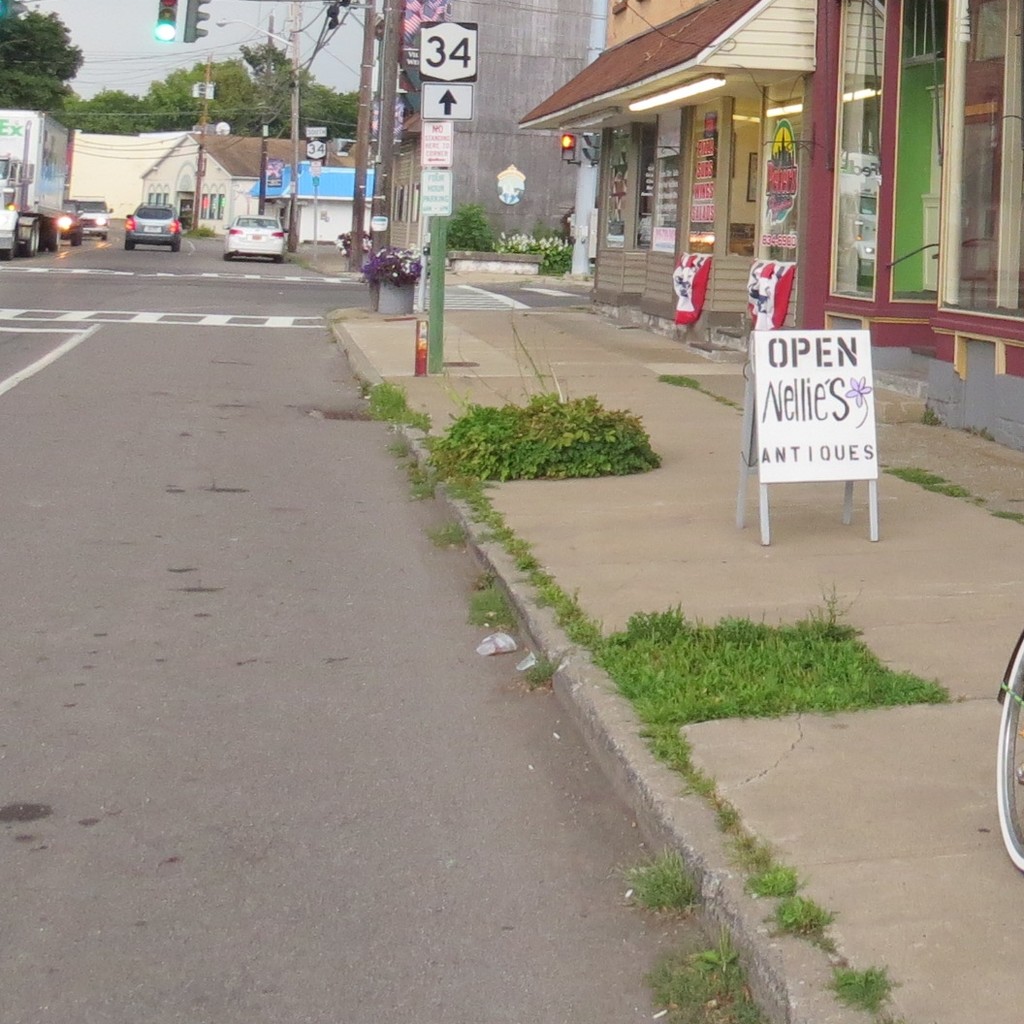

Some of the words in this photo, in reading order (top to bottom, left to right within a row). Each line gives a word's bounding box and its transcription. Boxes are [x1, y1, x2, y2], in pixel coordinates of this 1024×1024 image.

[426, 36, 472, 69] 34
[432, 125, 444, 133] NO
[308, 144, 326, 155] 34
[768, 336, 858, 368] OPEN
[761, 444, 875, 464] ANTIQUES
